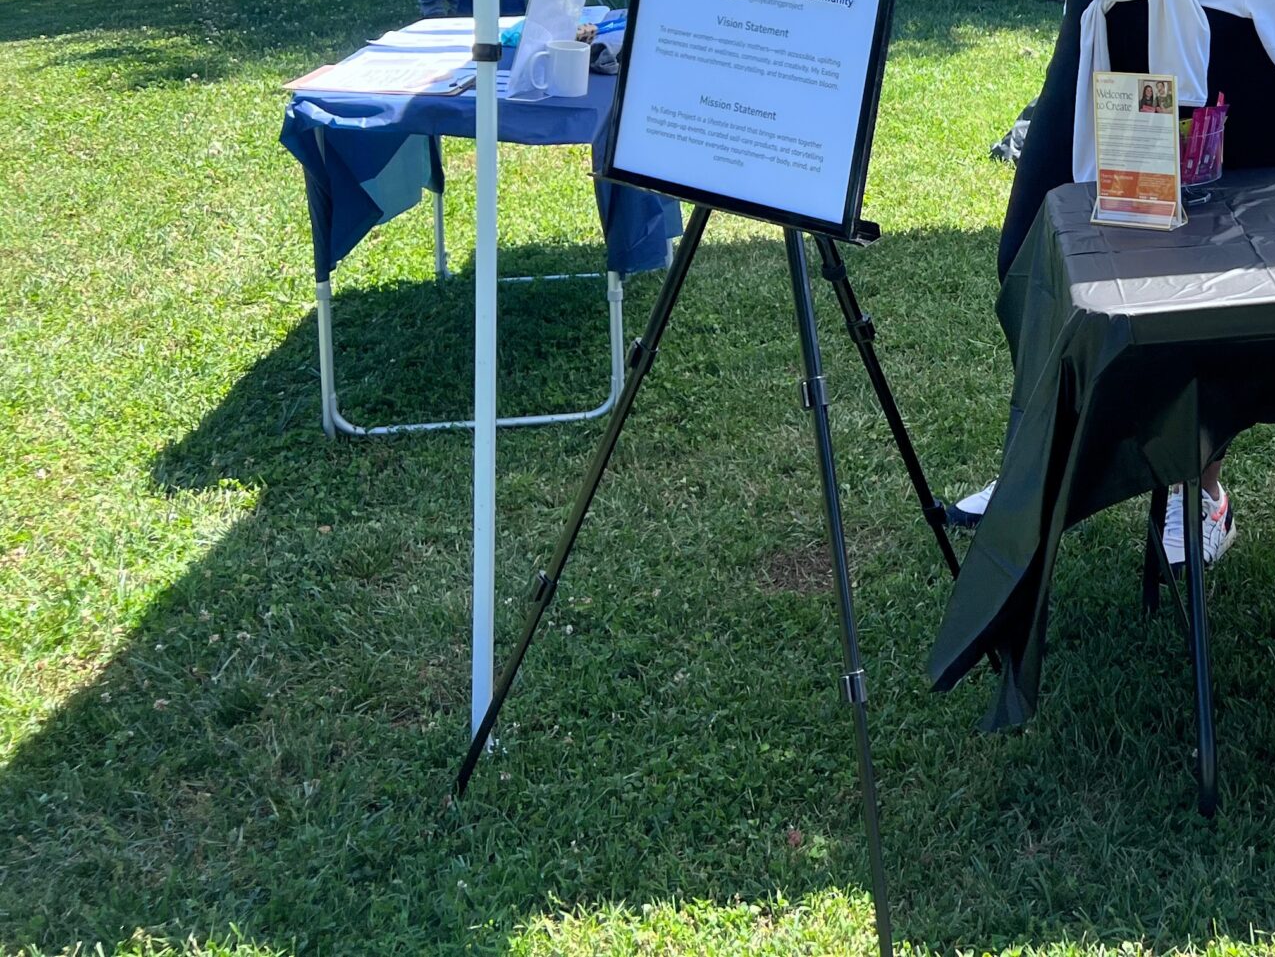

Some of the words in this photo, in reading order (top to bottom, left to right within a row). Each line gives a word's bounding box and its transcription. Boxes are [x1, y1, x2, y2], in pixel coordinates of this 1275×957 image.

[716, 15, 743, 28] Vision
[745, 21, 789, 37] Statement
[821, 67, 840, 79] Eating
[1097, 88, 1133, 100] Welcome
[700, 95, 731, 110] Mission
[733, 102, 777, 120] Statement
[1097, 101, 1105, 111] to
[1106, 101, 1132, 112] Create
[660, 106, 676, 116] Eating
[677, 111, 696, 121] Project
[730, 123, 746, 131] brand
[758, 129, 776, 139] brings
[798, 138, 823, 150] together
[688, 136, 704, 145] honor
[705, 141, 730, 152] everyday
[708, 129, 729, 139] curated
[791, 148, 824, 162] storytelling
